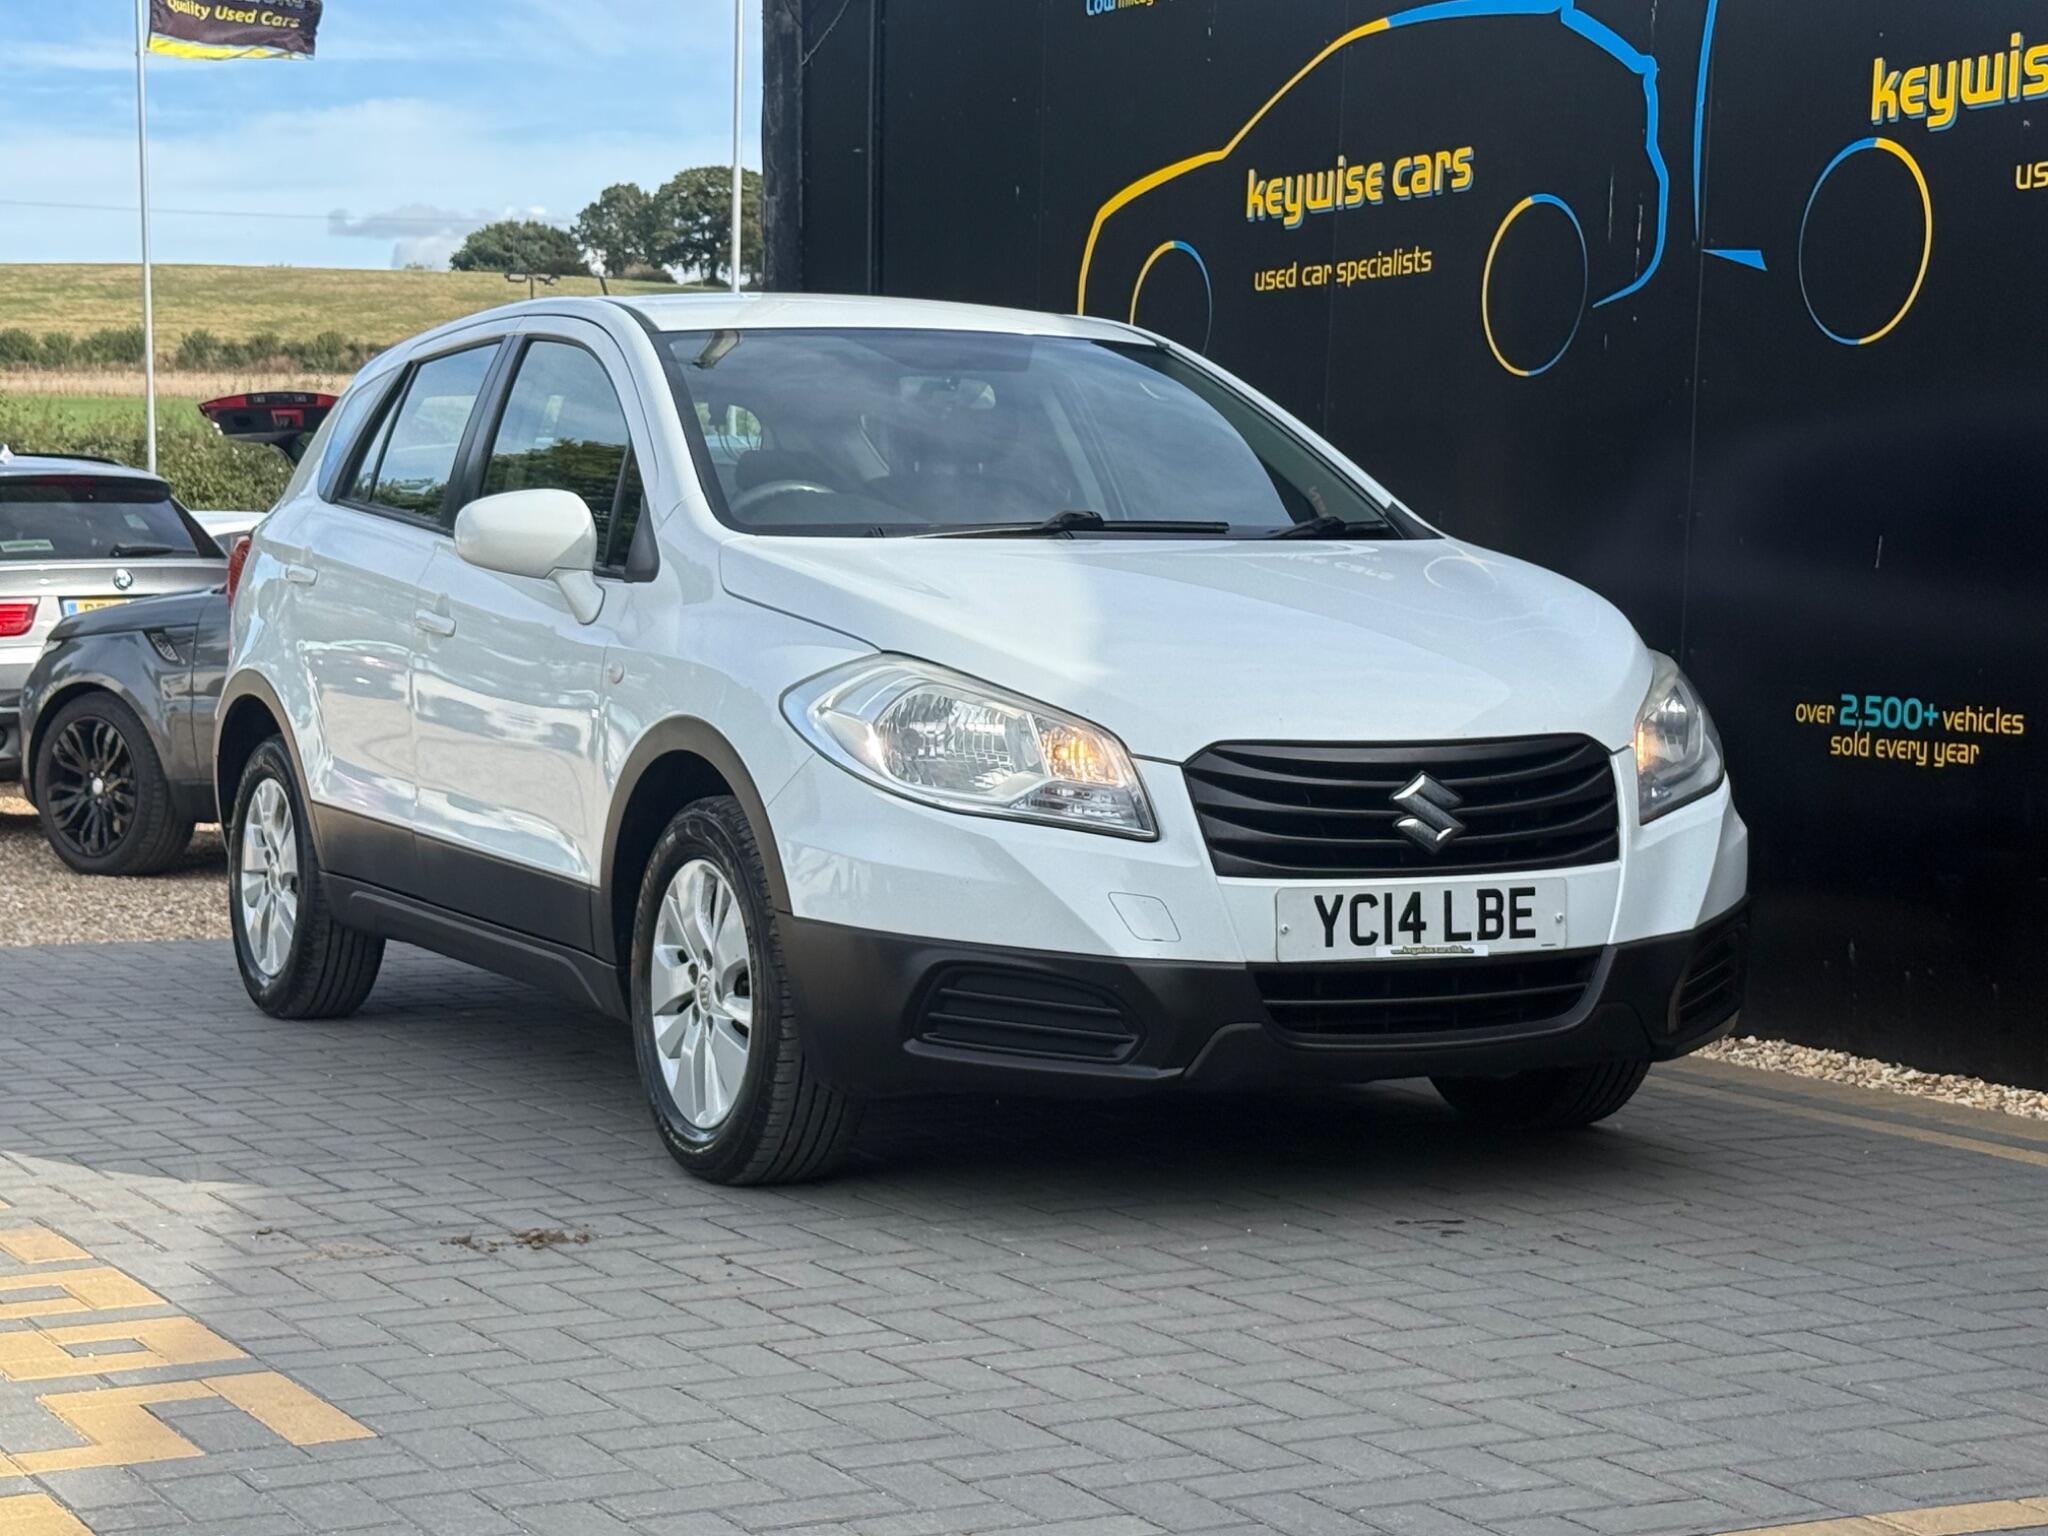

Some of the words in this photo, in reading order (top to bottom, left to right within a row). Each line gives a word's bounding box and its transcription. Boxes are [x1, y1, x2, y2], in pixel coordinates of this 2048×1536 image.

[167, 0, 211, 21] Quality
[214, 5, 257, 24] Used
[260, 11, 301, 28] Cars
[1246, 155, 1384, 230] keywise
[1392, 146, 1474, 200] cars
[1254, 261, 1298, 292] used
[1301, 263, 1333, 287] car
[1336, 246, 1433, 288] specialists
[1795, 703, 1836, 724] over
[1839, 693, 1939, 732] 2,500+
[1942, 705, 2025, 735] vehicles
[1830, 731, 1870, 757] sold
[1875, 738, 1928, 766] every
[1933, 741, 1980, 768] year
[1314, 891, 1427, 948] YC14
[1444, 886, 1537, 943] LBE
